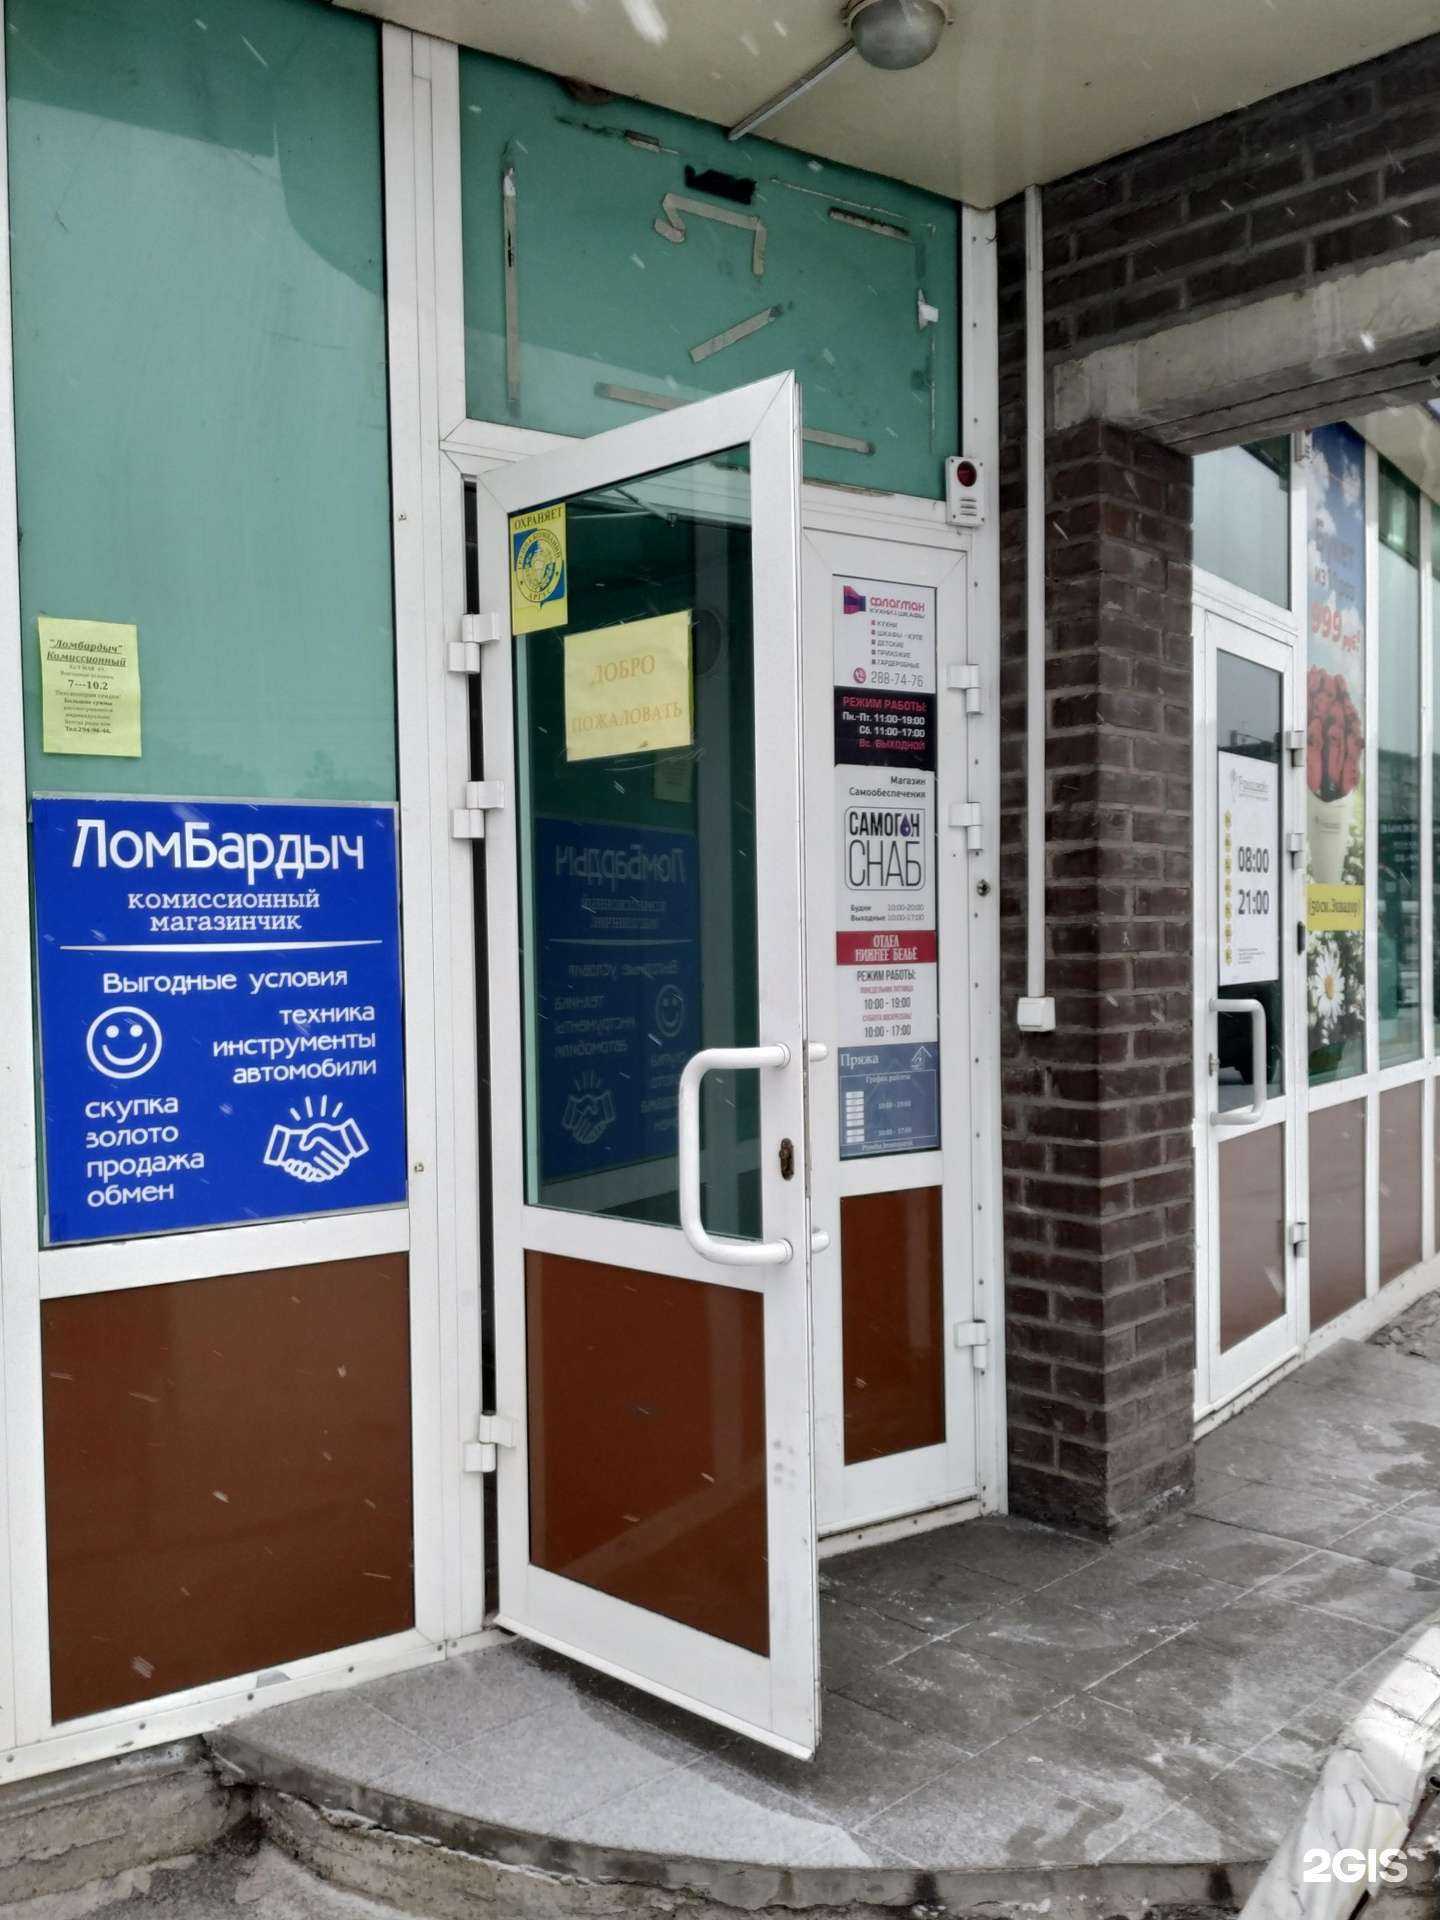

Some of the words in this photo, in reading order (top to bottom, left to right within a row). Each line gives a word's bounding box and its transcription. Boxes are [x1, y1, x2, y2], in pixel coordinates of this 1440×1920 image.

[514, 506, 562, 531] ОХРАНЯЕТ
[592, 655, 656, 684] ДОБРО
[870, 671, 924, 688] 288-74-76
[842, 697, 882, 709] РЕЖИМ
[884, 699, 927, 712] РАБОТЫ:
[572, 701, 683, 733] ПОЖАЛОВАТЬ
[874, 714, 925, 725] 11:00-19:00
[874, 726, 925, 737] 11:00-17:00
[890, 775, 926, 786] Магазин
[849, 787, 926, 799] Самообеспечения
[849, 839, 922, 887] СНАБ
[1237, 845, 1270, 875] 08:00
[128, 888, 320, 910] комиссионный
[1237, 889, 1270, 915] 21:00
[150, 912, 303, 932] магазинчик
[873, 934, 900, 948] ОТДЕЛ
[855, 948, 891, 962] НИЖНЕЕ
[102, 971, 237, 996] Выгодные
[249, 969, 348, 995] условия
[857, 970, 885, 982] РЕЖИМ
[864, 998, 885, 1010] 10:00
[891, 997, 911, 1009] 19:00
[278, 1004, 376, 1026] техника
[864, 1026, 885, 1038] 10:00
[891, 1025, 911, 1037] 17:00
[212, 1031, 377, 1061] инструменты
[232, 1058, 377, 1085] автомобили
[840, 1053, 880, 1070] Пряжа
[85, 1095, 179, 1124] скупка
[85, 1125, 179, 1149] золото
[86, 1150, 205, 1183] продажа
[86, 1183, 175, 1208] обмен
